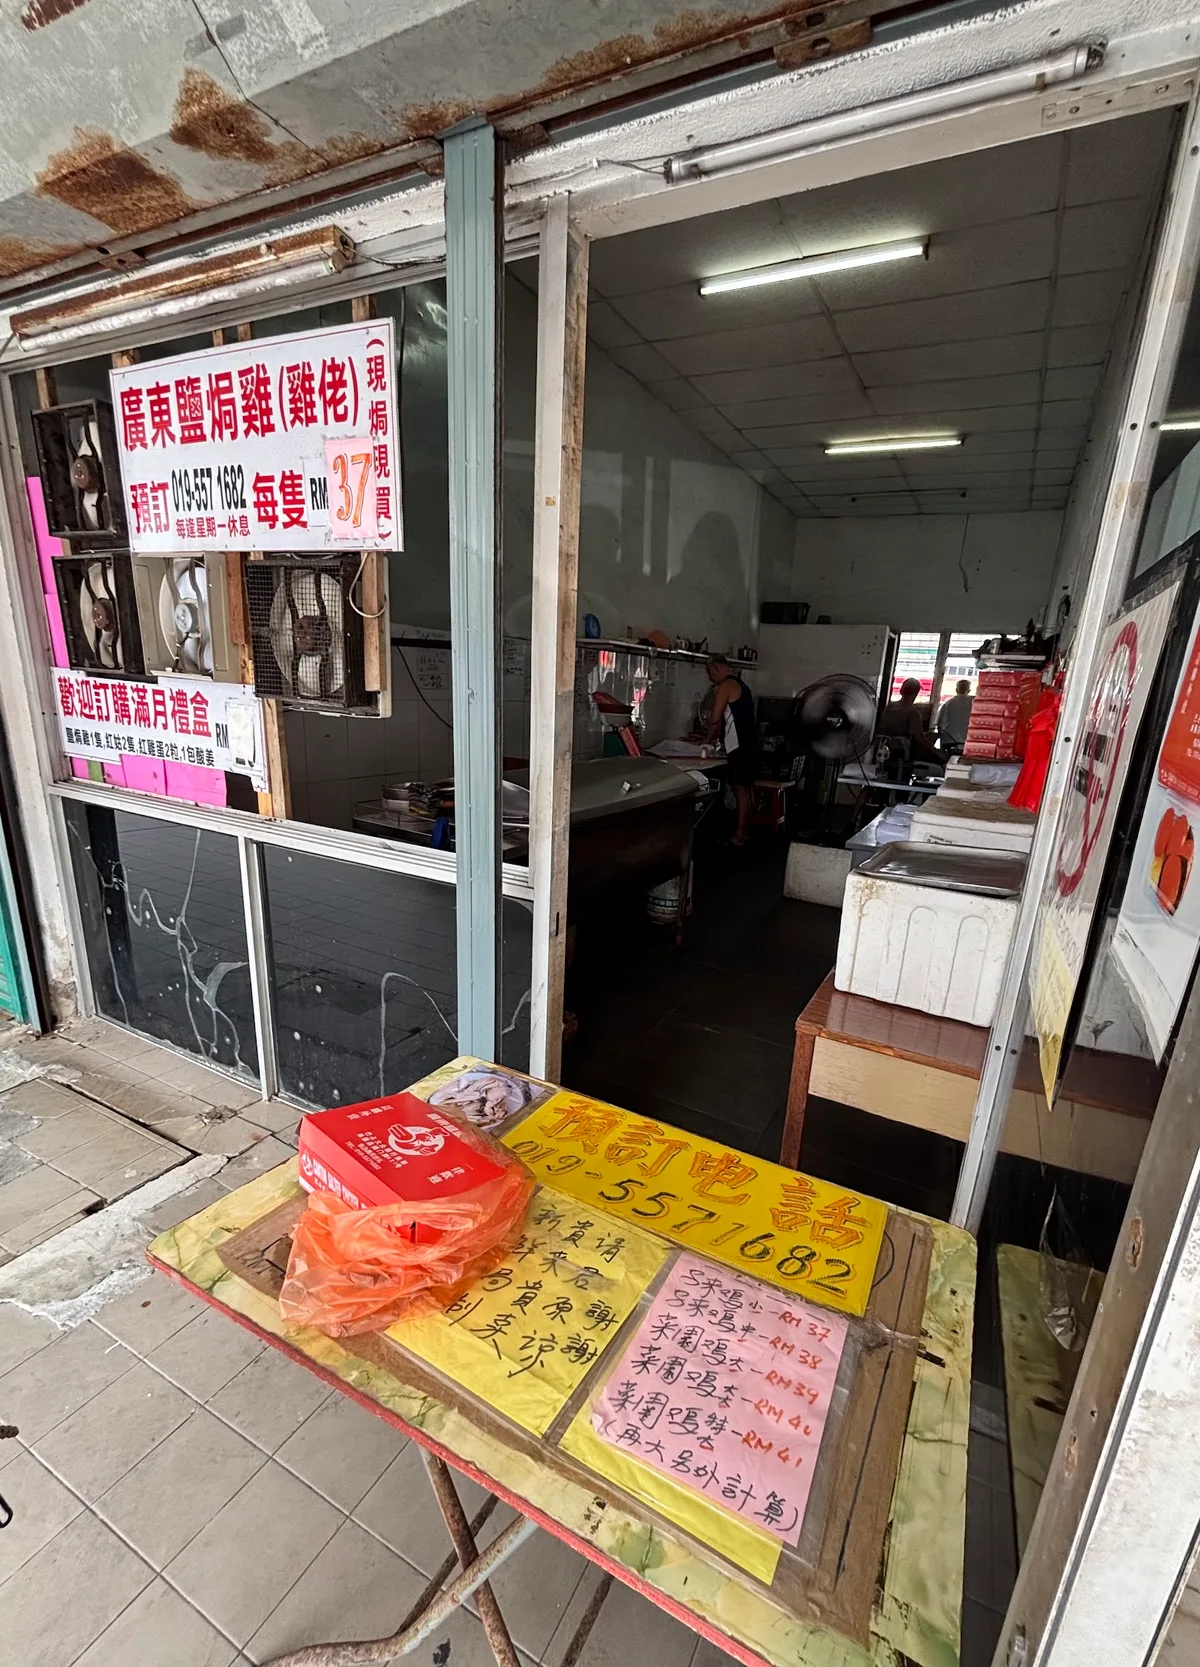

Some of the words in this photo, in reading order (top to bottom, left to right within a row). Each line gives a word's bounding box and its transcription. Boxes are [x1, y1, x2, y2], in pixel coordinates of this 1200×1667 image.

[130, 480, 170, 534] 預訂
[217, 464, 248, 511] 1682
[252, 469, 310, 530] 每隻
[333, 452, 372, 528] 37
[175, 515, 251, 539] 每逢星期一休息
[215, 722, 230, 749] RM
[807, 1323, 832, 1343] 37
[799, 1350, 823, 1370] 38
[792, 1383, 819, 1405] 39
[777, 1448, 803, 1468] 41
